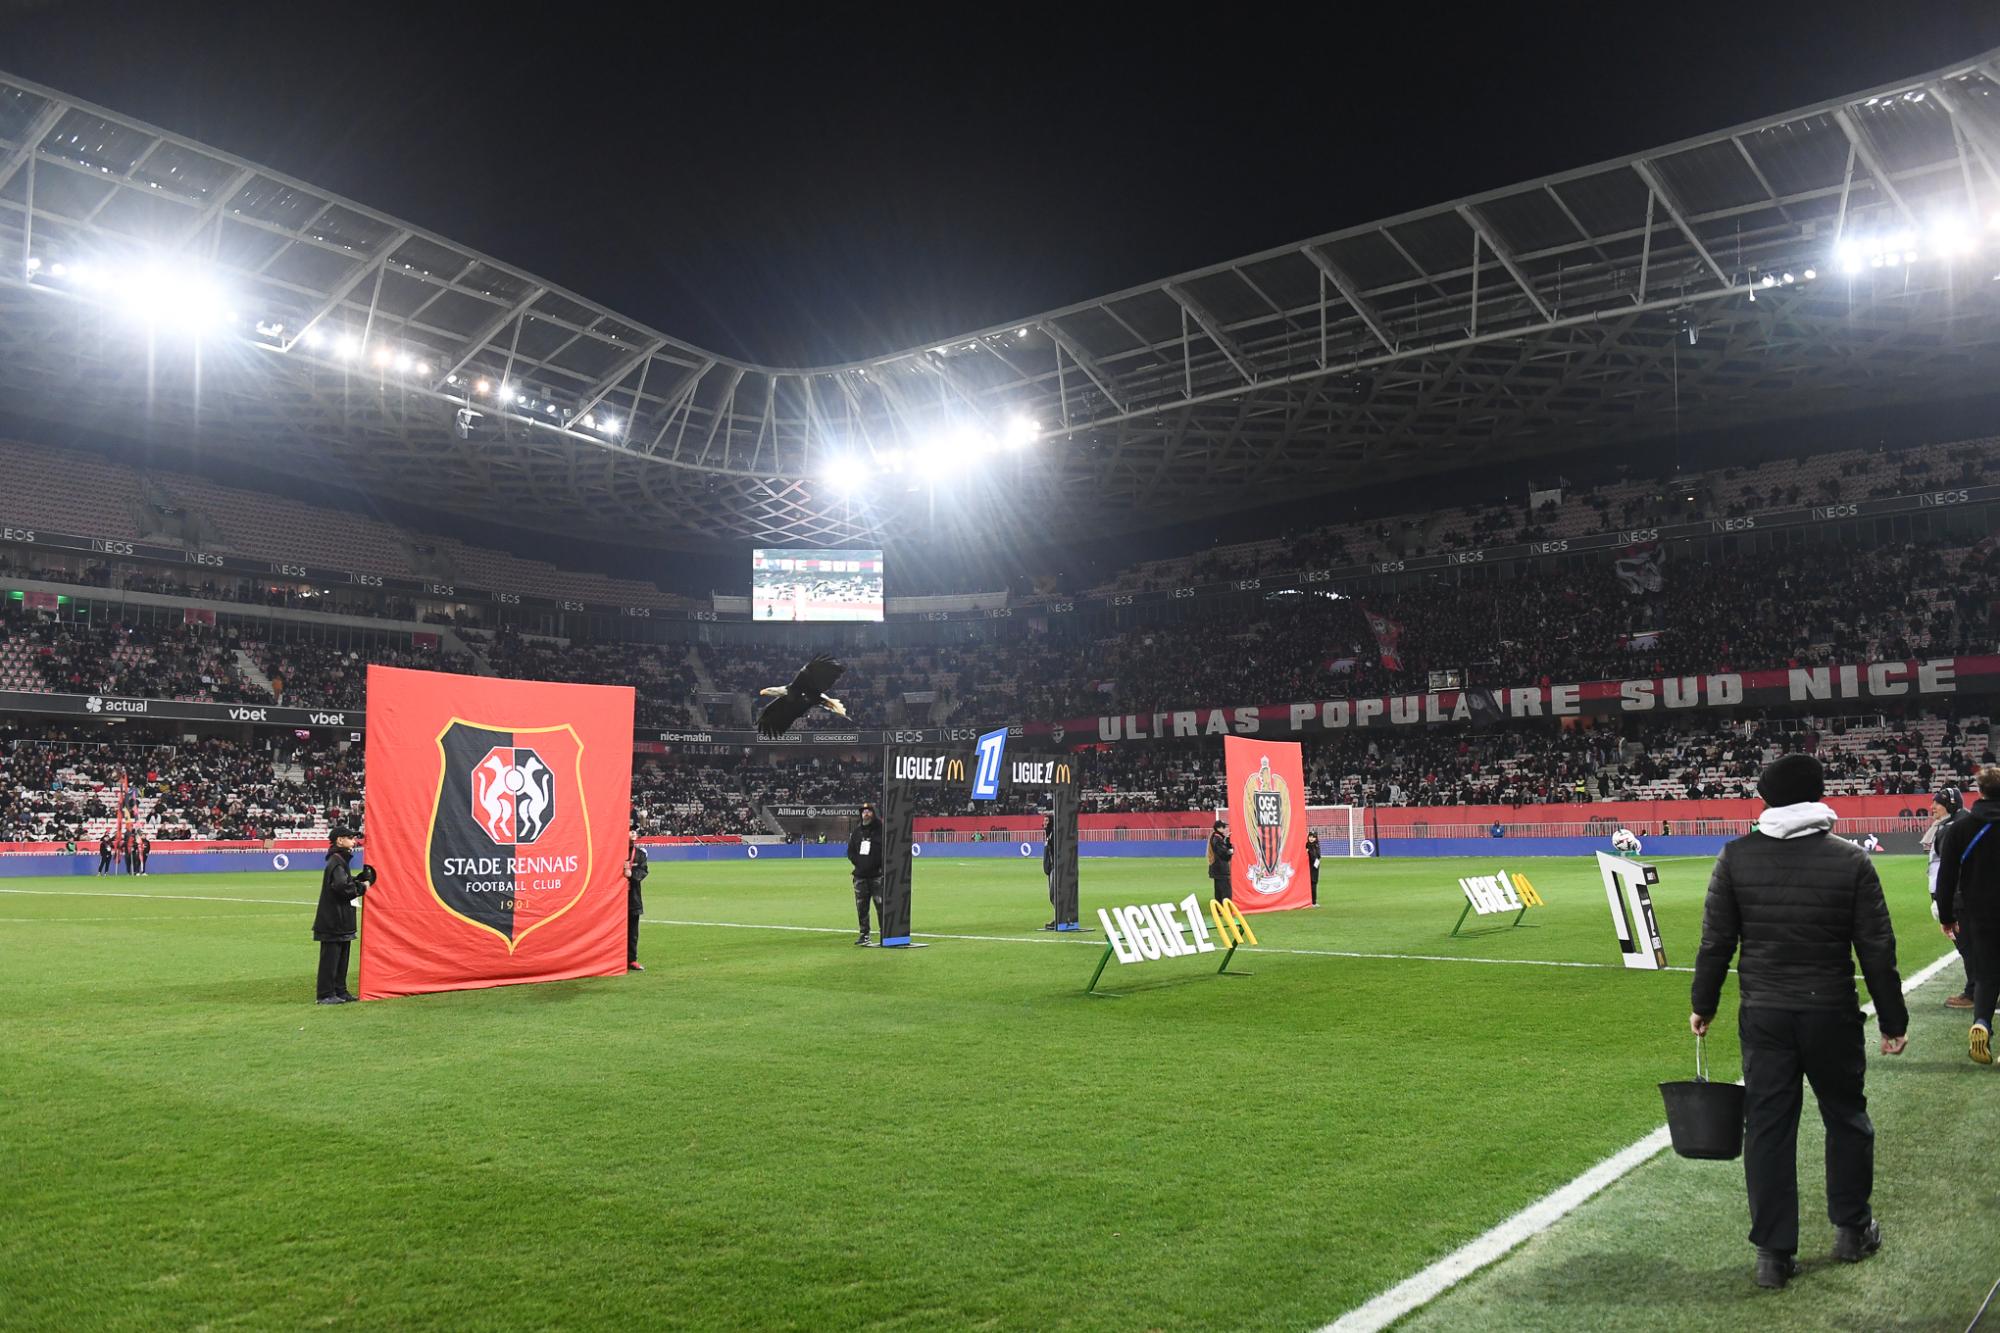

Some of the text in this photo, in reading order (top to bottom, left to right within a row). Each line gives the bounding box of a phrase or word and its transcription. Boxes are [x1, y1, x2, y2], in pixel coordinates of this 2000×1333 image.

[1919, 488, 1970, 507] INEOS
[1812, 505, 1858, 521] INEOS
[1712, 517, 1755, 532] INEOS
[1617, 528, 1659, 545] INEOS
[91, 539, 134, 556] INEOS
[1530, 540, 1568, 554] INEOS
[185, 551, 225, 567] INEOS
[1447, 551, 1484, 565] INEOS
[270, 563, 307, 578] INEOS
[1371, 561, 1405, 574] INEOS
[350, 573, 384, 587] INEOS
[1299, 570, 1330, 583] INEOS
[423, 583, 454, 597] INEOS
[1231, 579, 1261, 591] INEOS
[491, 592, 521, 605] INEOS
[555, 600, 585, 612] INEOS
[687, 609, 719, 622] INEOS
[105, 700, 148, 713] actual
[1098, 706, 1260, 741] ULTRAS
[1620, 673, 1744, 711] SUD
[1787, 659, 1958, 702] NICE
[229, 707, 267, 722] vbet
[309, 711, 345, 726] vbet
[660, 731, 712, 743] nice-matin
[882, 730, 924, 744] INEOS
[939, 728, 977, 742] INEOS
[896, 756, 933, 780] LIGUE
[1012, 762, 1043, 784] LIGUE
[1258, 796, 1277, 811] OGC
[777, 807, 805, 816] Allianz
[1259, 811, 1278, 826] NICE
[443, 855, 578, 876] STADE RENNAIS
[465, 878, 562, 893] FOOTBALL CLUB
[1097, 902, 1197, 965] LIGUE
